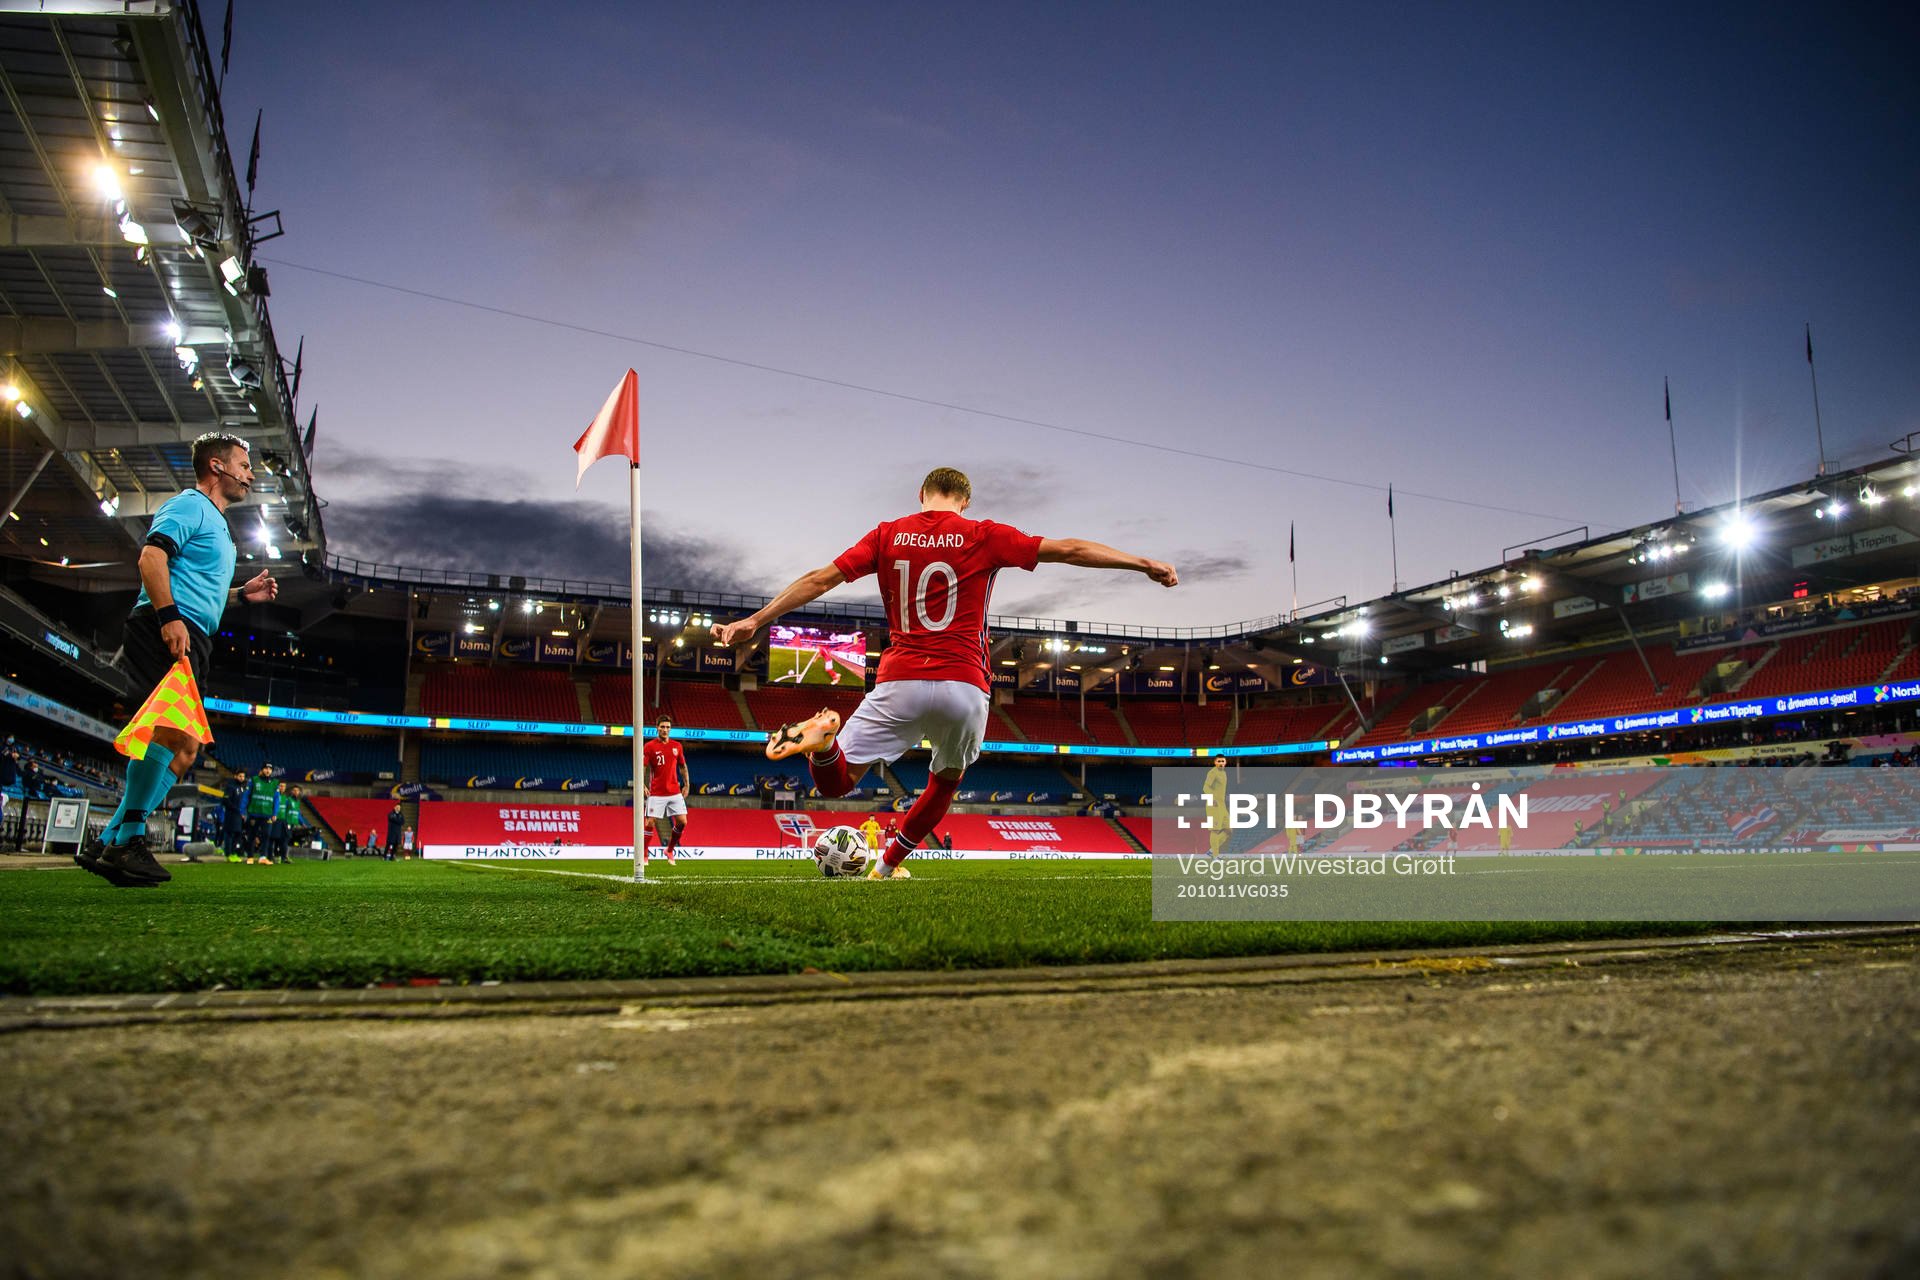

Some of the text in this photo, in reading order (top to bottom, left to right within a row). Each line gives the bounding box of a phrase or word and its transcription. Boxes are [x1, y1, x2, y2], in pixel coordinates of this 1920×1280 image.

[893, 532, 964, 548] ØDEGAARD
[893, 560, 958, 634] 10
[460, 639, 490, 651] bama
[545, 645, 574, 656] bama
[705, 655, 732, 666] bama
[1056, 676, 1079, 686] bama
[1148, 678, 1173, 688] bama
[214, 701, 233, 710] SLEEP
[286, 710, 308, 719] SLEEP
[1705, 704, 1763, 719] Norsk Tipping
[335, 714, 359, 723] SLEEP
[386, 717, 410, 725] SLEEP
[467, 721, 490, 729] SLEEP
[515, 723, 538, 731] SLEEP
[564, 725, 586, 734] SLEEP
[1558, 724, 1604, 736] Norsk Tipping
[685, 730, 706, 738] SLEEP
[729, 732, 750, 741] SLEEP
[985, 743, 1003, 751] SLEEP
[1082, 747, 1099, 755] SLEEP
[1298, 744, 1314, 752] SLEEP
[657, 755, 665, 766] 21
[499, 808, 581, 821] STERKERE
[504, 820, 579, 832] SAMMEN
[988, 820, 1056, 831] STERKERE
[1000, 831, 1063, 841] SAMMEN
[466, 847, 547, 857] PHANTOM
